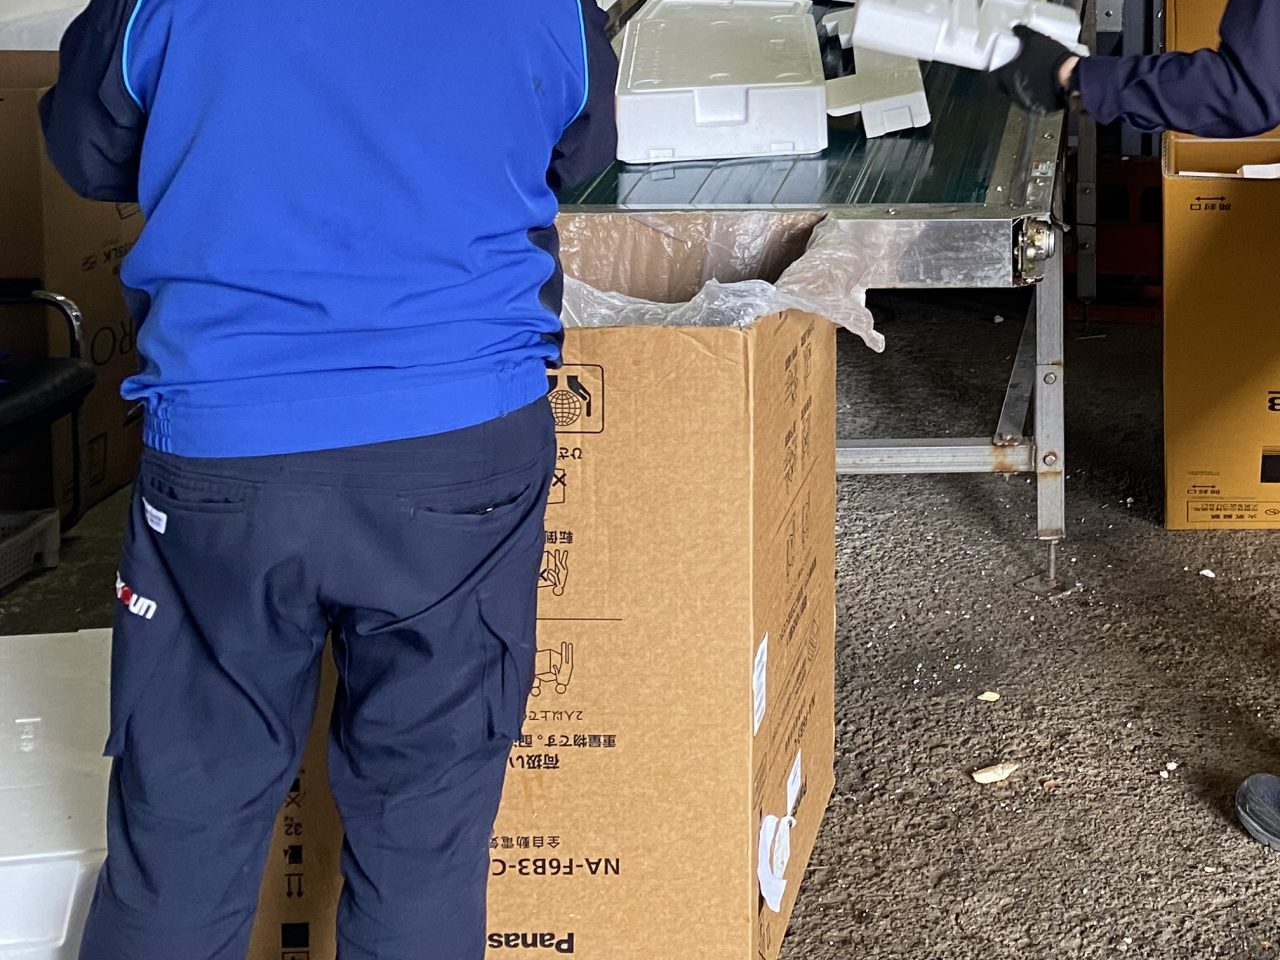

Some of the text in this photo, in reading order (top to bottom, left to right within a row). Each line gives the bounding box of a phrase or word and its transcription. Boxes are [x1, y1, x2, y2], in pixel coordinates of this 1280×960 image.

[557, 447, 583, 460] ひざ
[524, 710, 584, 721] 2人以上で
[512, 734, 617, 748] 重量物です。配
[508, 754, 560, 770] 荷扱い
[284, 822, 303, 836] 32
[491, 857, 620, 876] NA-F6B3-C
[487, 932, 575, 954] Panas
